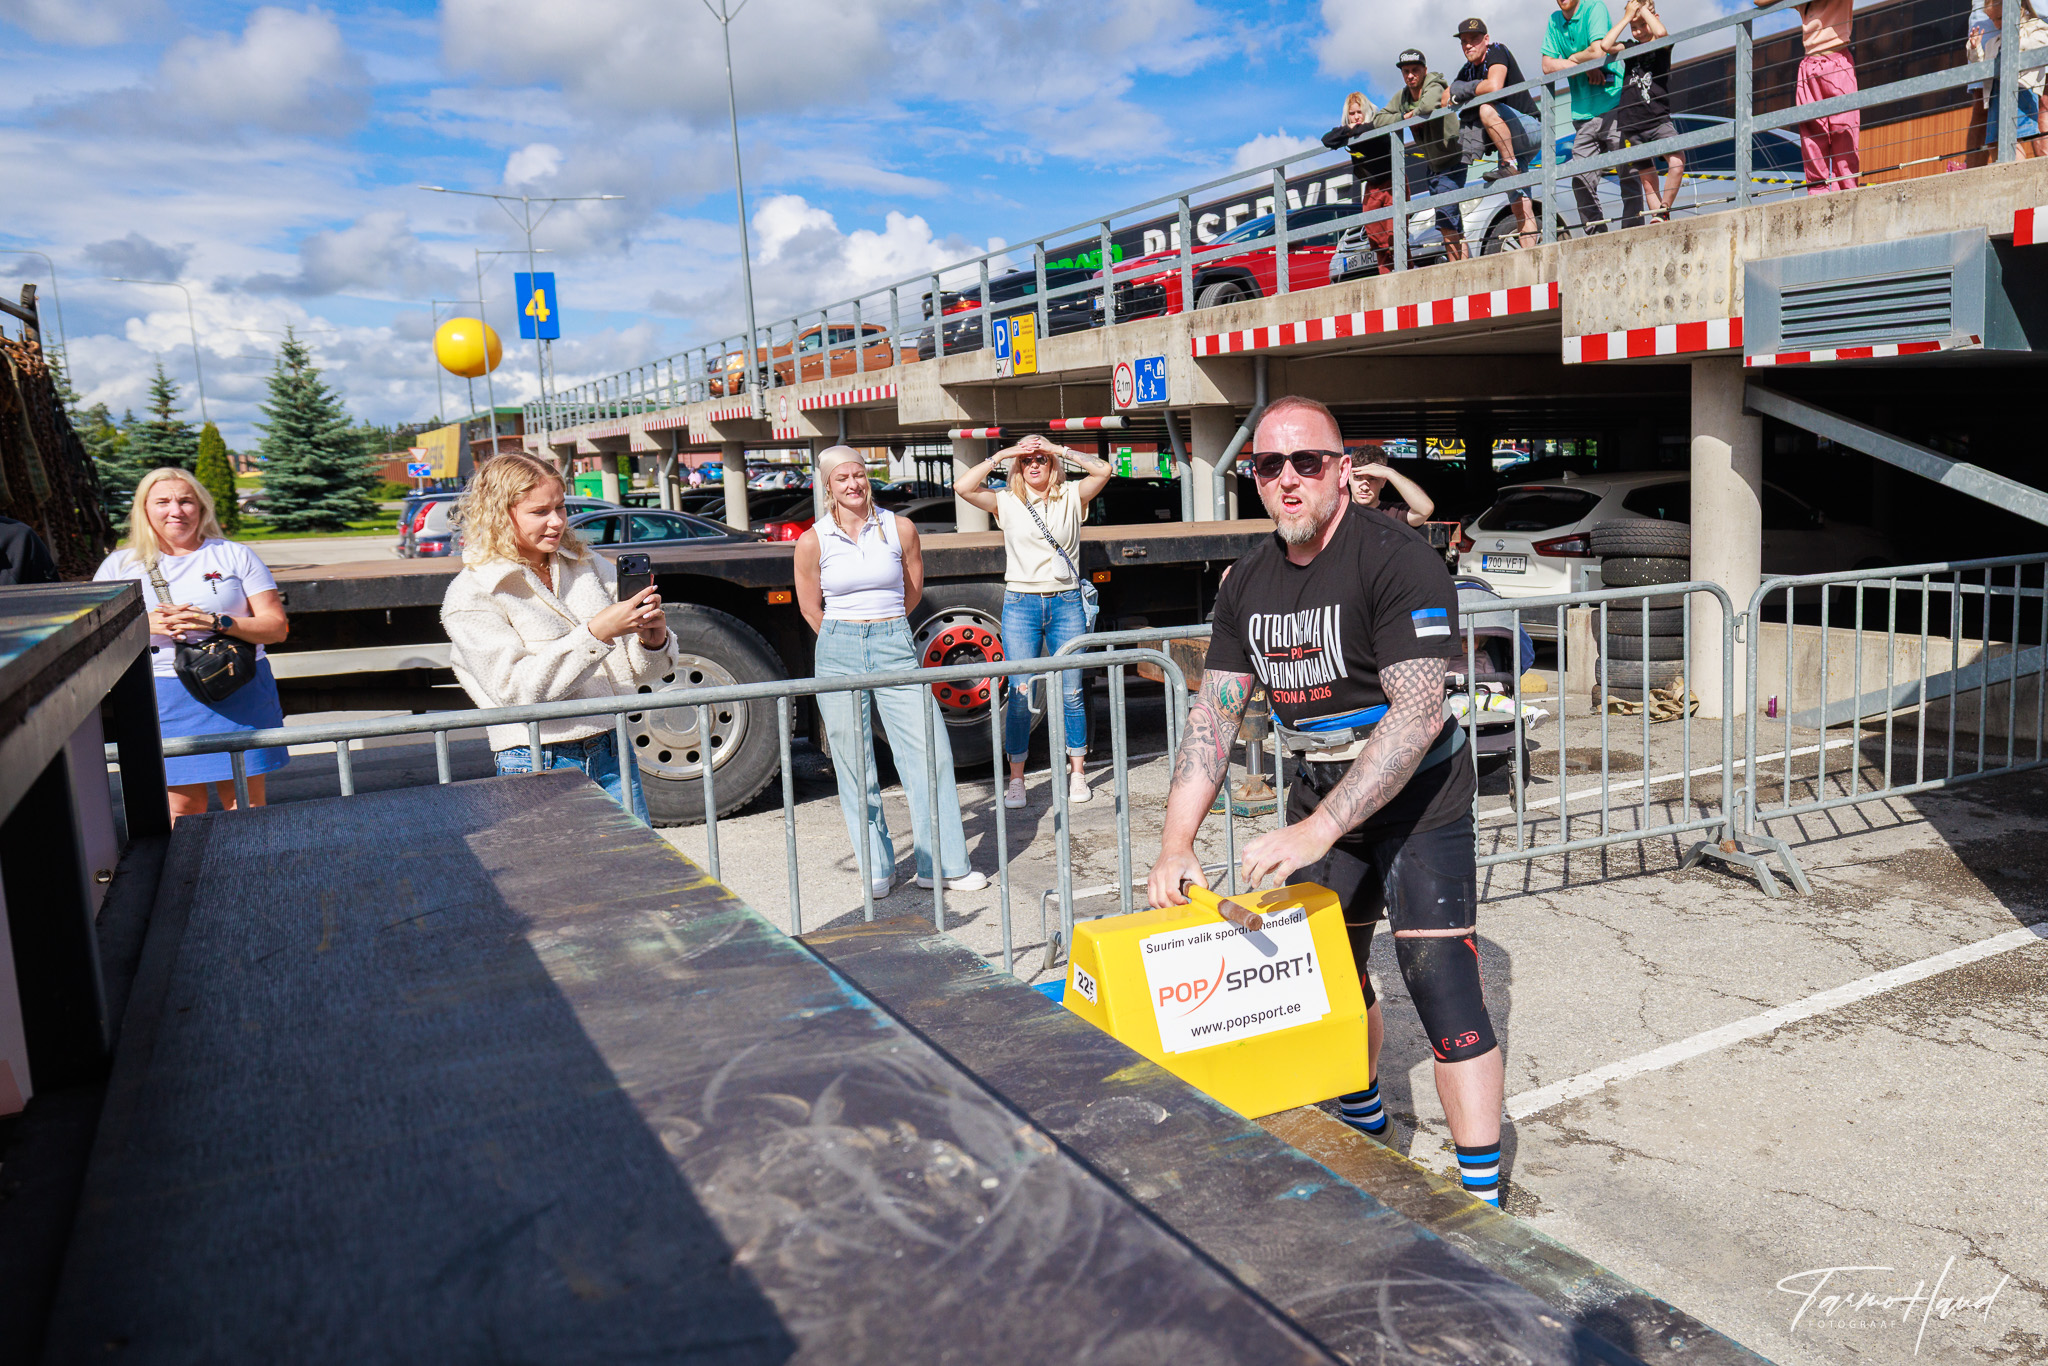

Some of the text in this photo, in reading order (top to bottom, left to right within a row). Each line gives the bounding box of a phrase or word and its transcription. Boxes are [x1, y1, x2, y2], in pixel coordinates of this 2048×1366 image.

[525, 289, 550, 322] 4
[996, 325, 1006, 356] P
[1488, 556, 1524, 569] 700 VFT
[1272, 685, 1332, 704] STONA 2026
[1146, 912, 1302, 954] Suurim valik spordihendeid!
[1159, 952, 1313, 1007] POP SPORT!
[1190, 1002, 1301, 1037] www.popsport.ee
